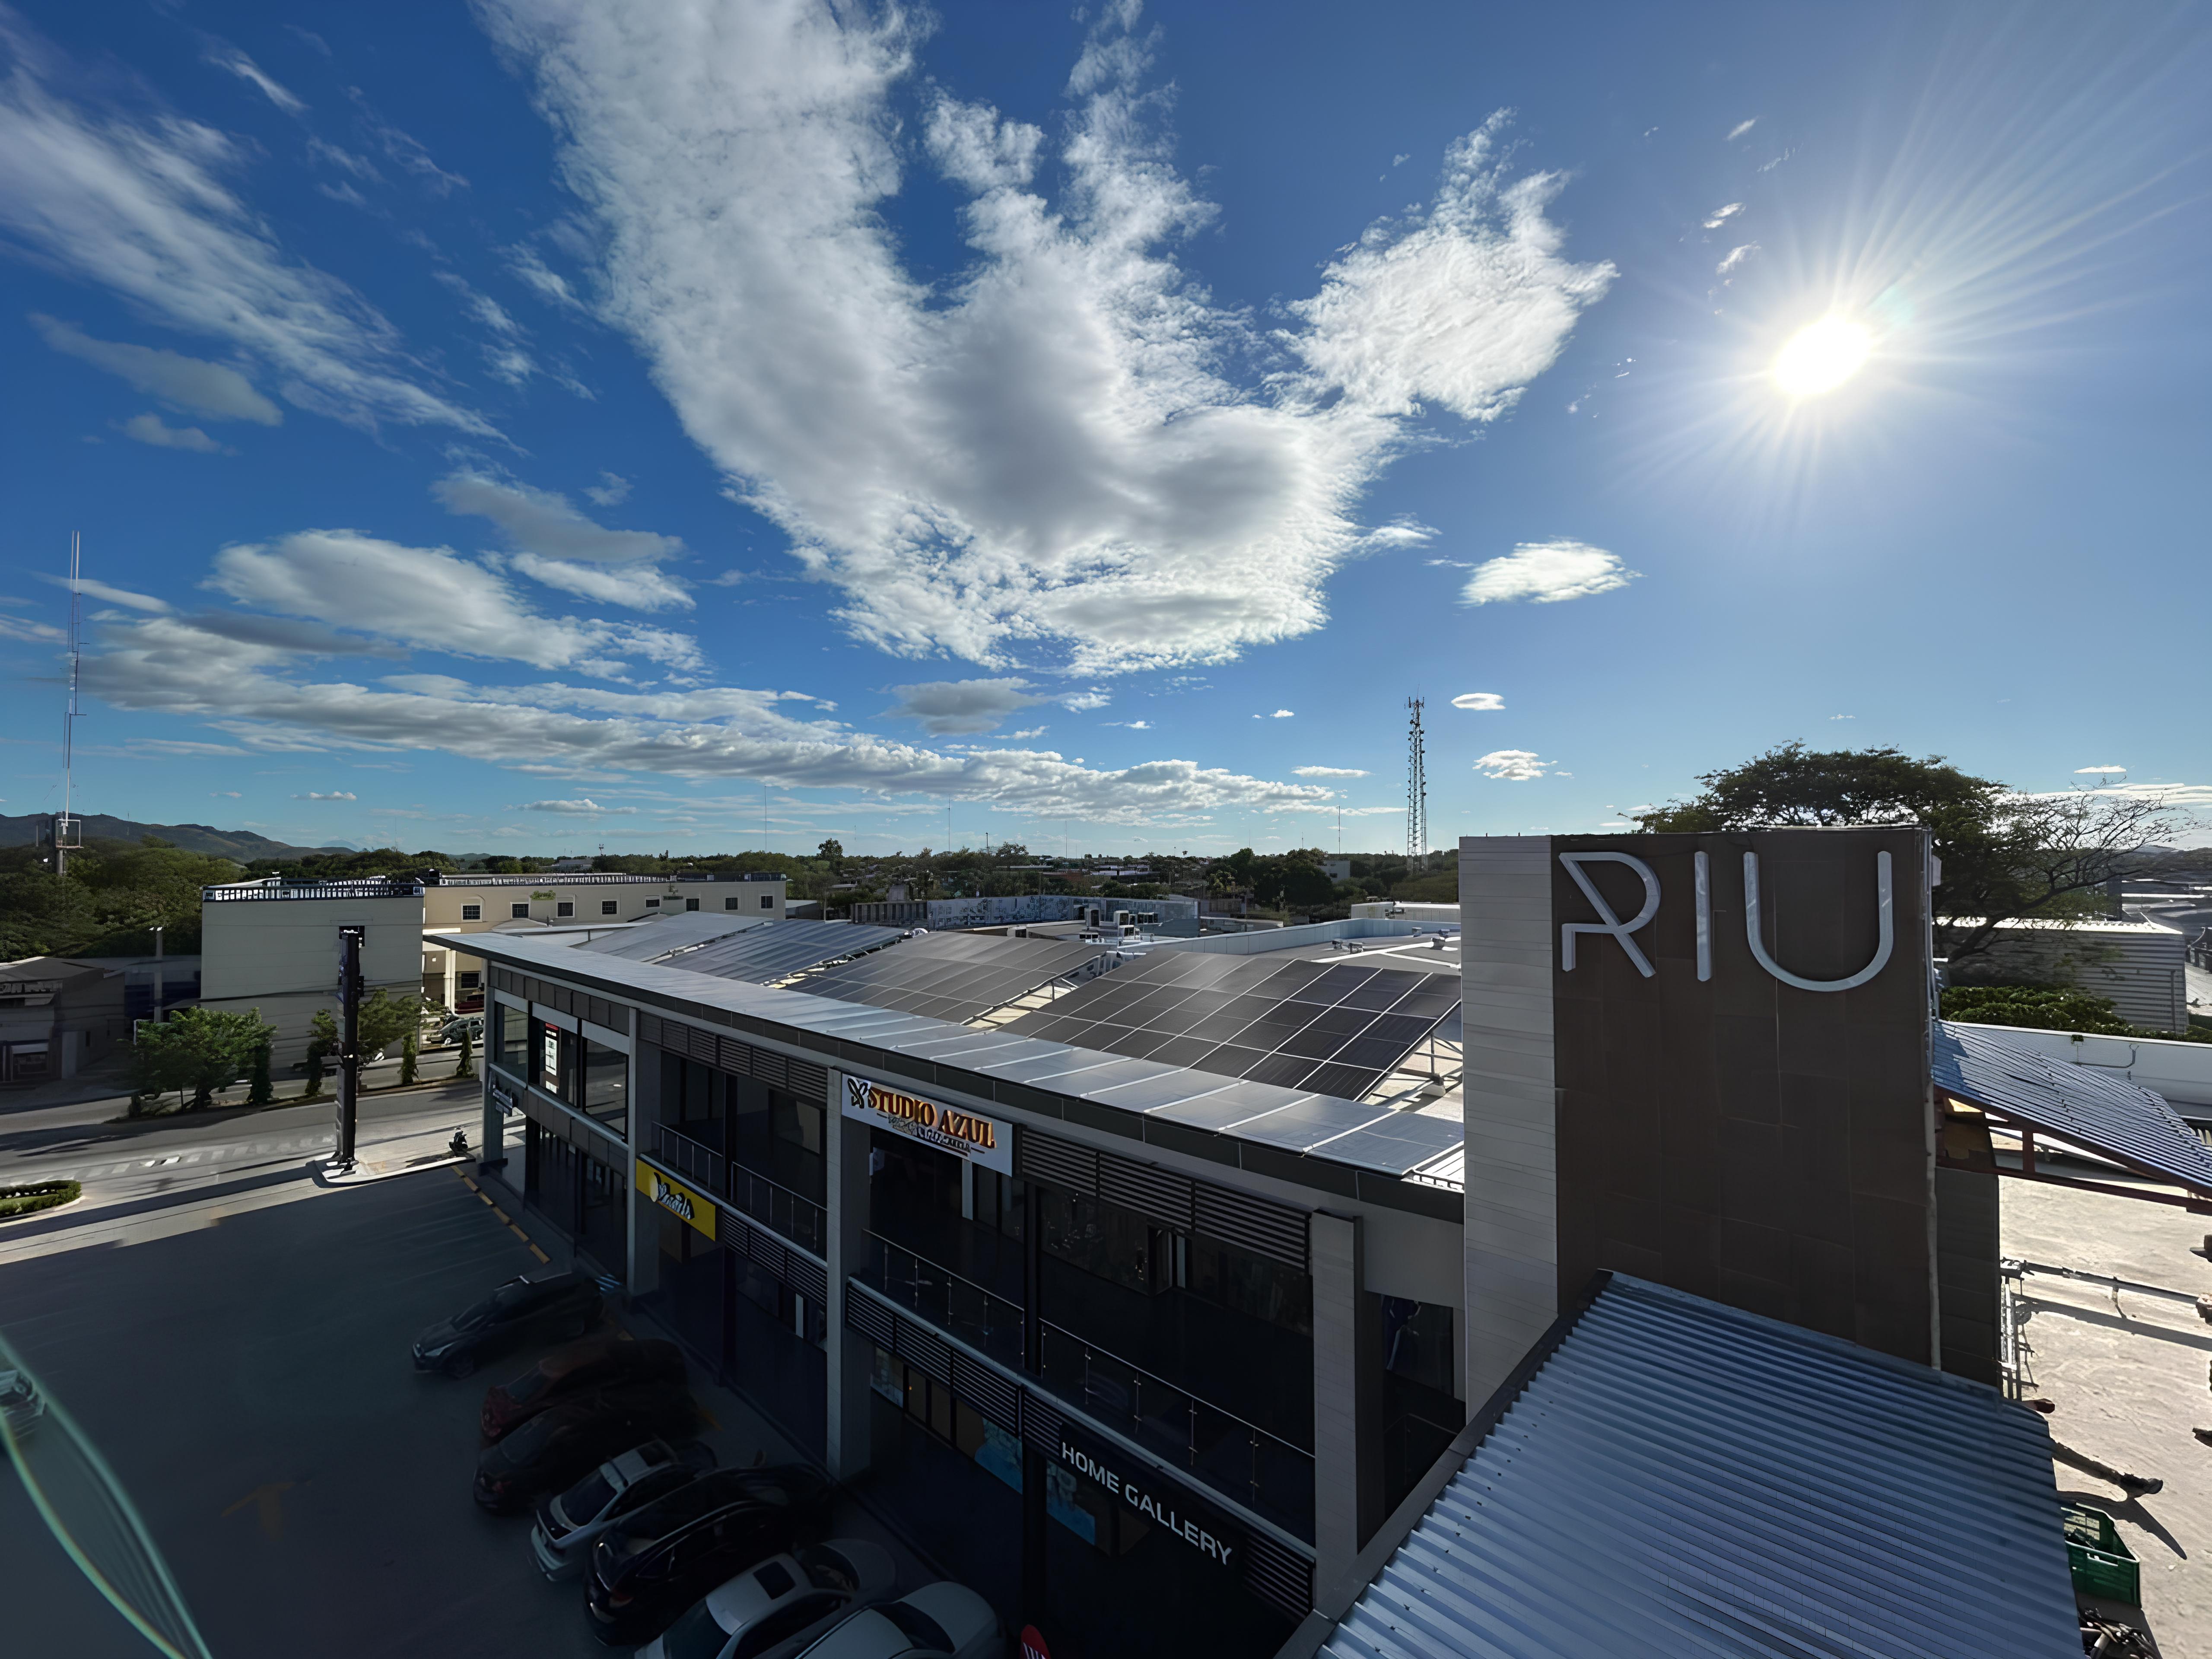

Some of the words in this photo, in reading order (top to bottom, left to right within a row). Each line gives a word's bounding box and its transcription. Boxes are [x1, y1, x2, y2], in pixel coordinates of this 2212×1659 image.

[1558, 851, 1894, 992] RIU
[868, 1087, 938, 1126] STUDIO
[938, 1109, 996, 1149] AZUL
[1062, 1442, 1119, 1494] HOME
[1125, 1484, 1232, 1565] GALLERY
